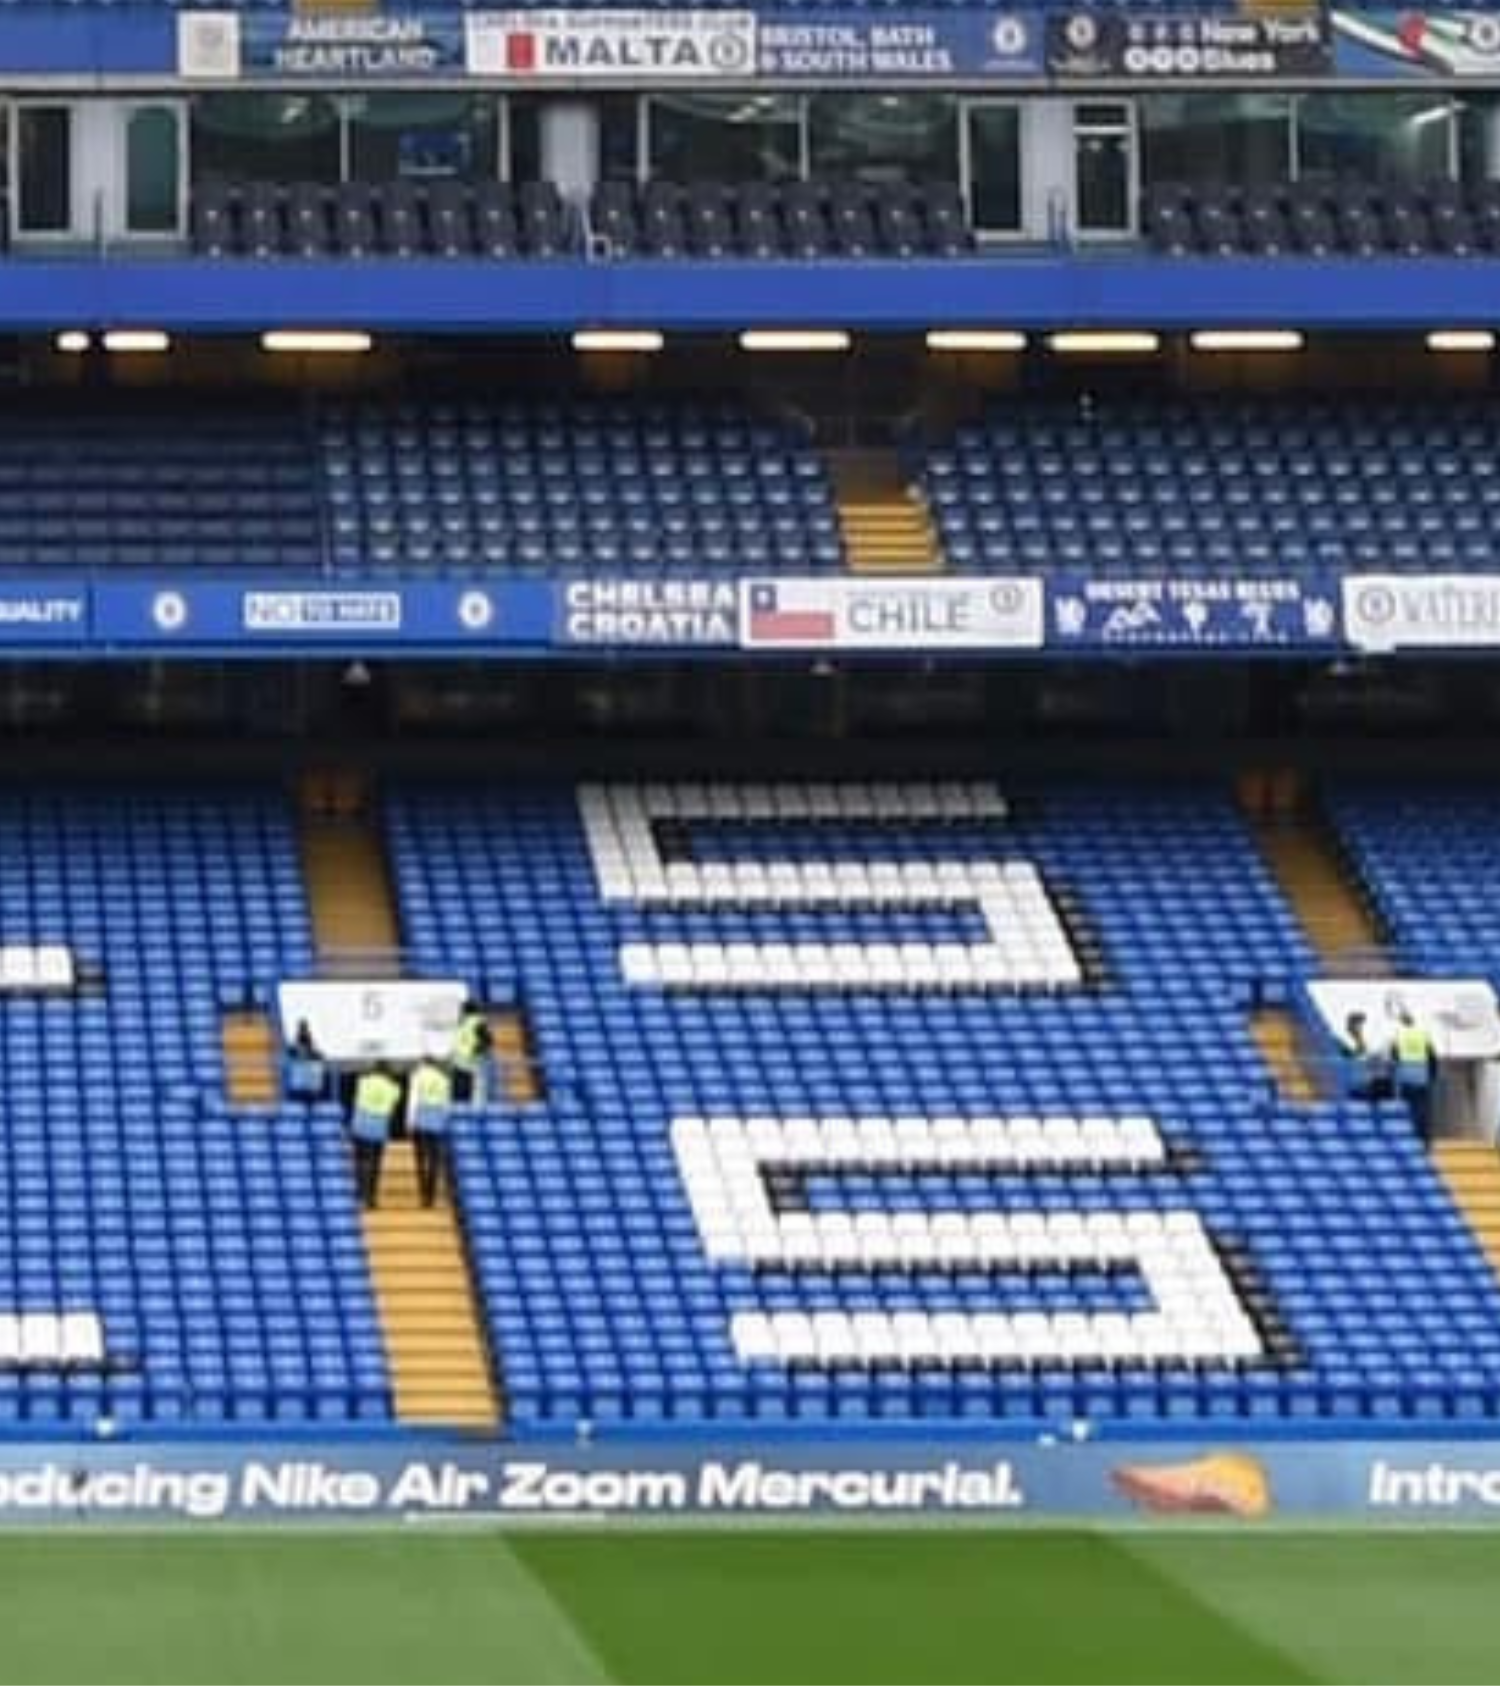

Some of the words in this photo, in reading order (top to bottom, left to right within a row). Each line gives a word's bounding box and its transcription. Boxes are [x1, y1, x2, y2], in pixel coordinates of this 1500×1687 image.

[286, 16, 423, 40] AMERICAN
[870, 24, 935, 46] BATH
[1200, 19, 1257, 43] New
[1263, 19, 1319, 43] York
[273, 46, 436, 70] HEARTLAND
[545, 36, 702, 65] MALTA
[781, 49, 869, 72] SOUTH
[870, 49, 952, 72] WALES
[1202, 47, 1276, 72] Blues
[567, 579, 736, 608] CHELSEA
[849, 594, 970, 633] CHILE
[568, 612, 735, 644] CROATIA
[241, 1462, 380, 1508] Nike
[387, 1462, 489, 1508] Air
[498, 1462, 686, 1508] Zoom
[699, 1461, 1022, 1507] Mercurial.
